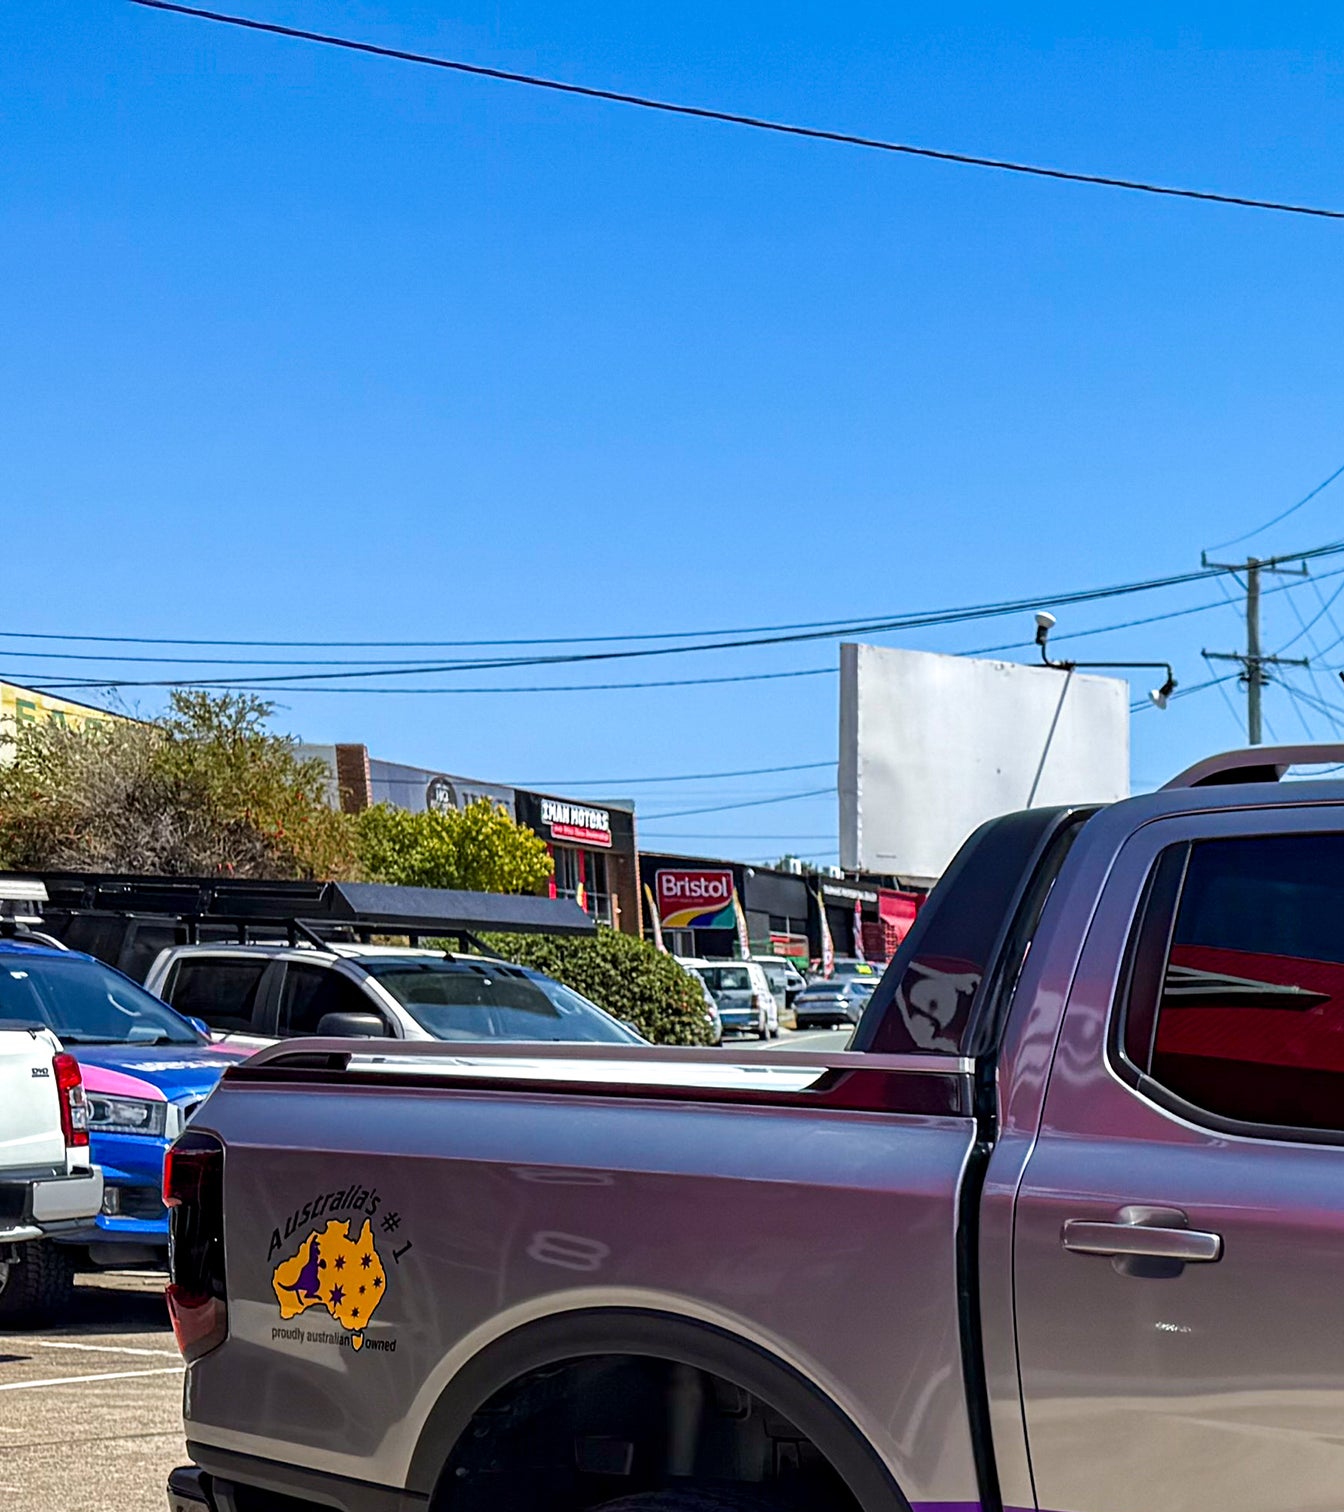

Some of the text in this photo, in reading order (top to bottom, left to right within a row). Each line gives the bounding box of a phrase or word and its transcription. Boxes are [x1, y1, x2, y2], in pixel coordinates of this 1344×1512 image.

[662, 875, 728, 897] Bristol
[267, 1184, 382, 1263] Australia's
[271, 1326, 397, 1352] proudly australian owned
